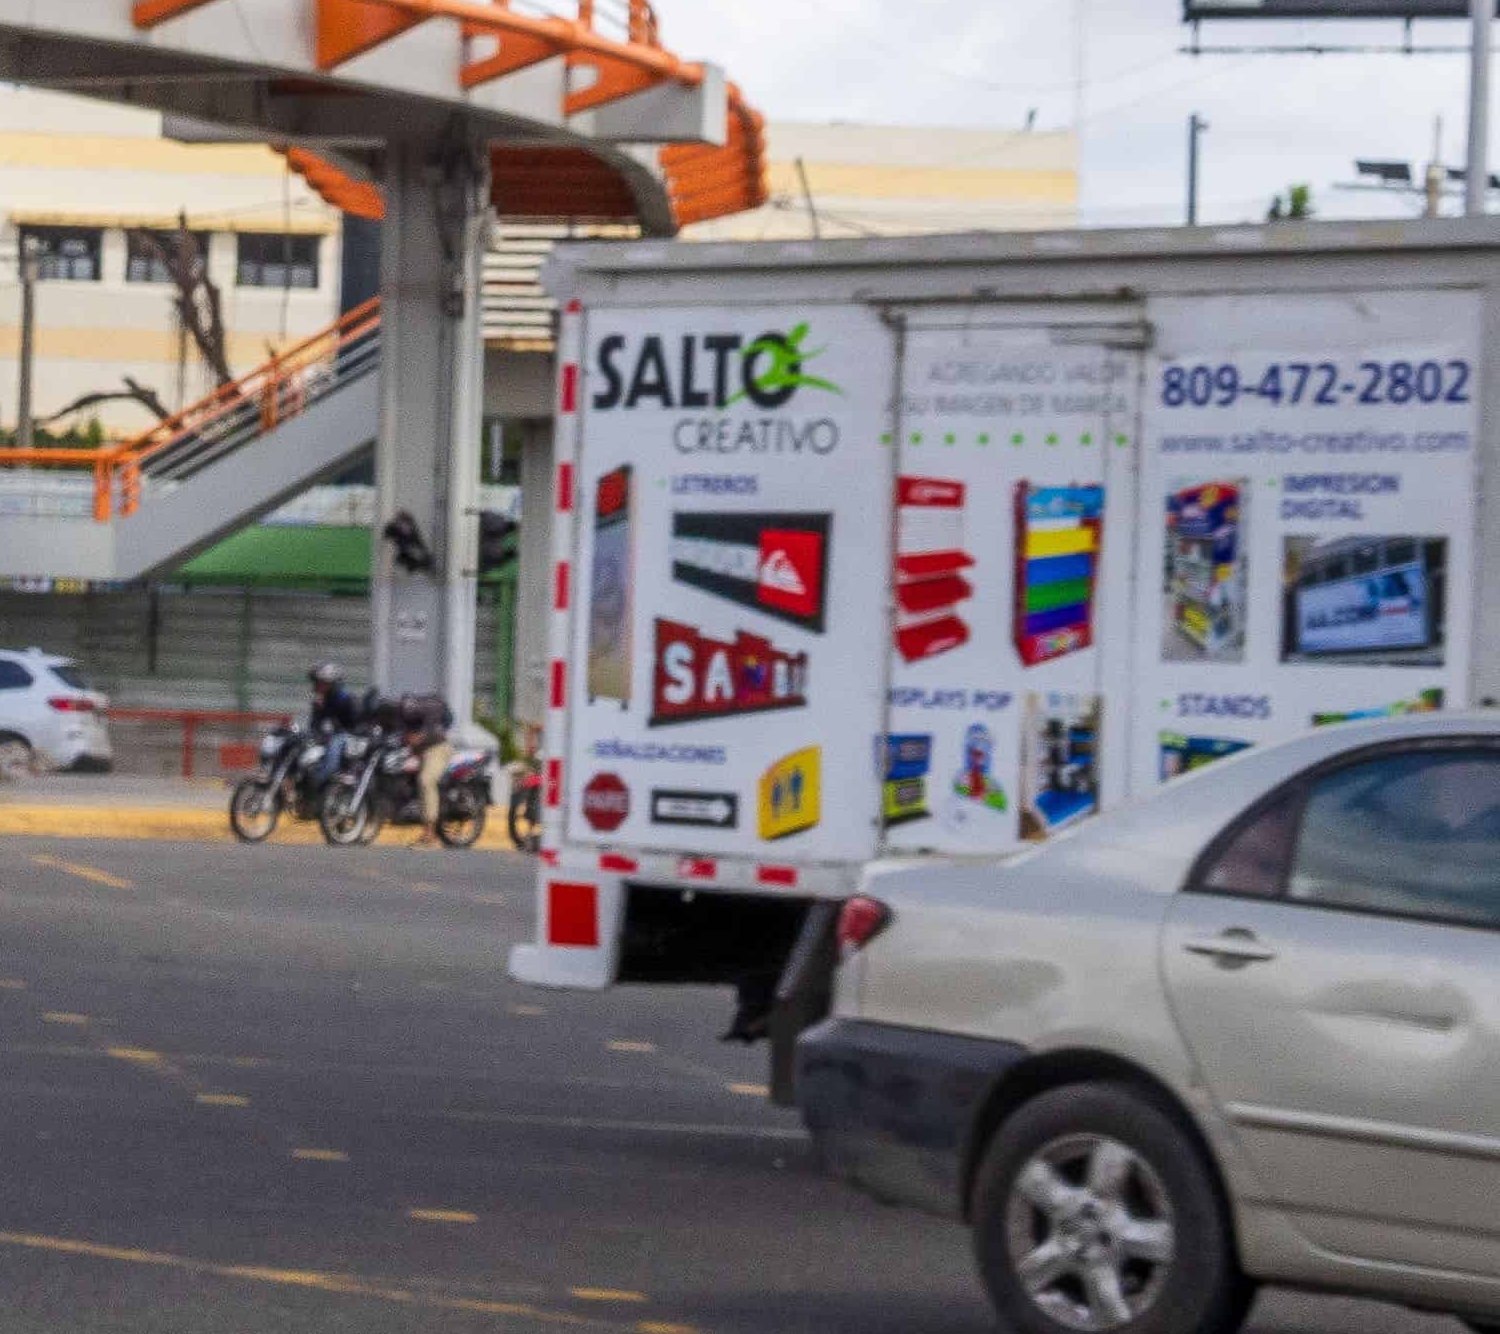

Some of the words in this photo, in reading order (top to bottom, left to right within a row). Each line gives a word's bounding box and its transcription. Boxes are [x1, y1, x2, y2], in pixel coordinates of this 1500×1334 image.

[593, 330, 801, 410] SALTO
[1161, 360, 1470, 408] 809-472-2802
[672, 418, 840, 455] CREATIVO
[1160, 430, 1470, 454] www.salto-creativo.com
[671, 474, 760, 495] LETREROS
[1280, 498, 1364, 521] DIGITAL
[972, 689, 1013, 711] POP
[1176, 693, 1272, 719] STANDS
